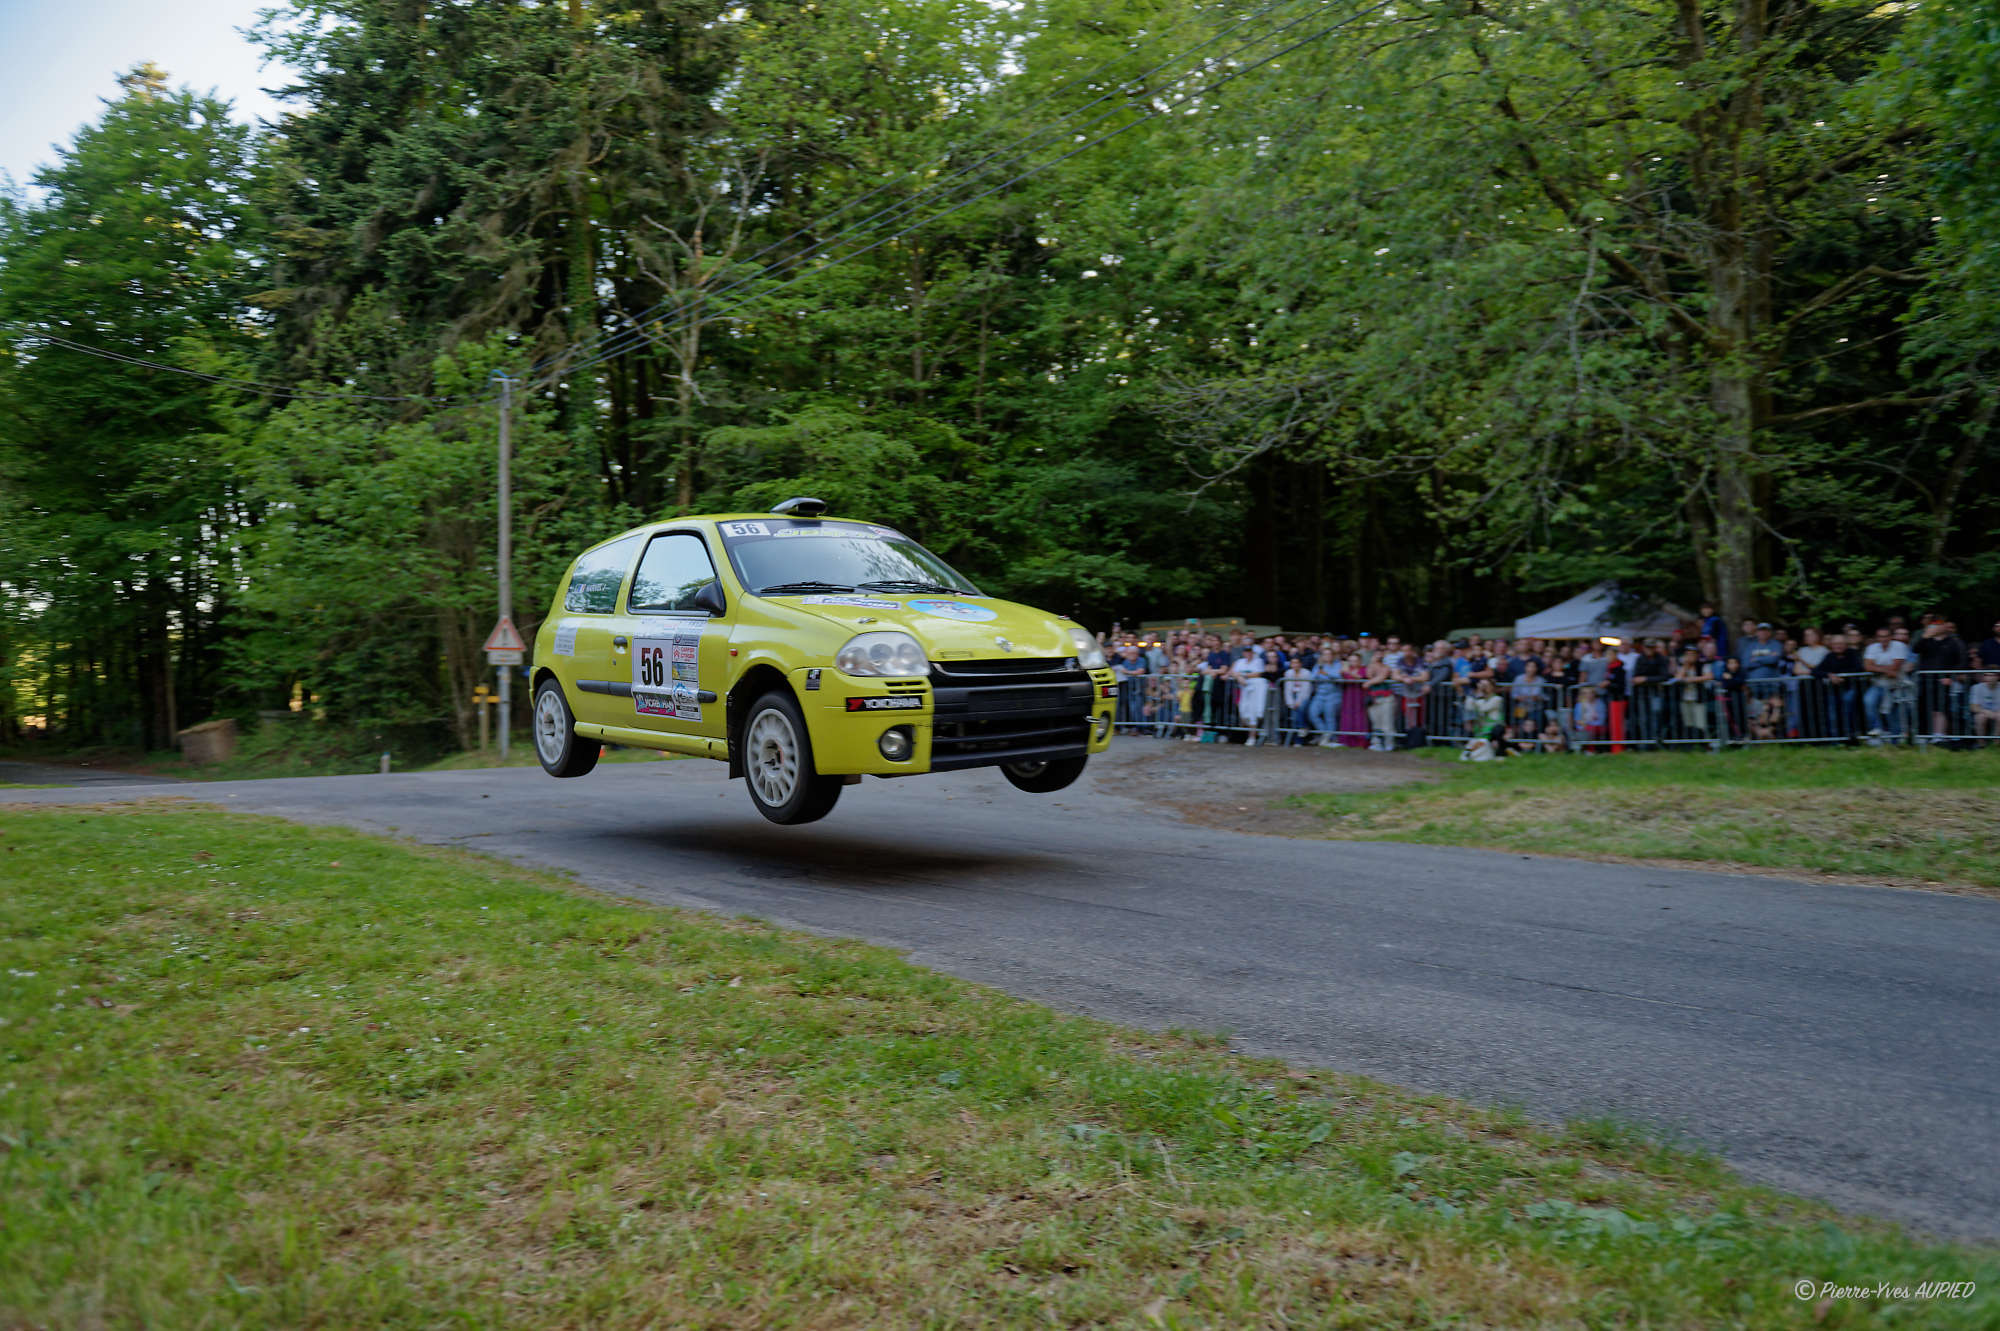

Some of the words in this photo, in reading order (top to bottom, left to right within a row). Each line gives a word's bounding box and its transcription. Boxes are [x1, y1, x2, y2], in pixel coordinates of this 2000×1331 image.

[732, 523, 760, 535] 56
[641, 647, 664, 687] 56
[863, 697, 922, 709] YOKOHAMA
